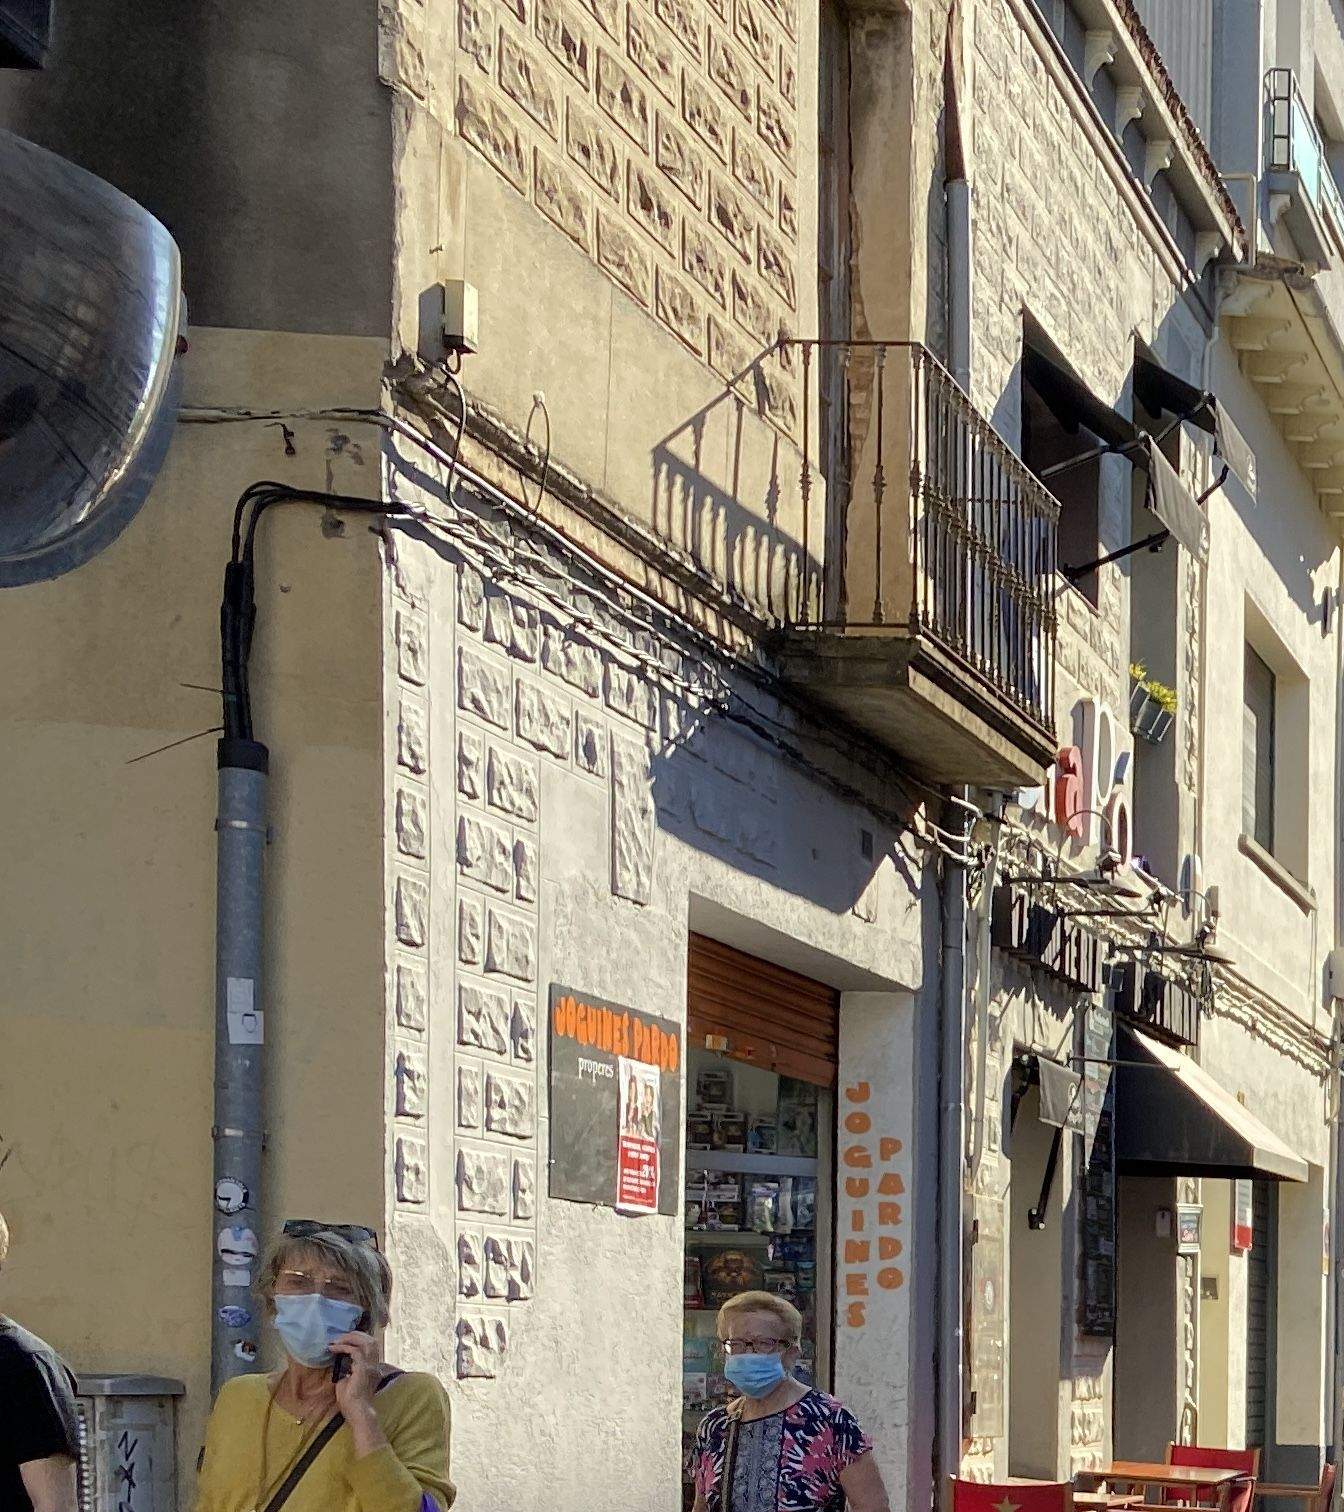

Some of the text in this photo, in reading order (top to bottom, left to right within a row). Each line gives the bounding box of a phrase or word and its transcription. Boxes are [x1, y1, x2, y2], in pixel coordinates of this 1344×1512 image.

[555, 996, 678, 1072] JOGUINES PARDO
[578, 1057, 614, 1083] properes
[843, 1082, 873, 1327] JOGUINES
[876, 1137, 905, 1290] PARDO
